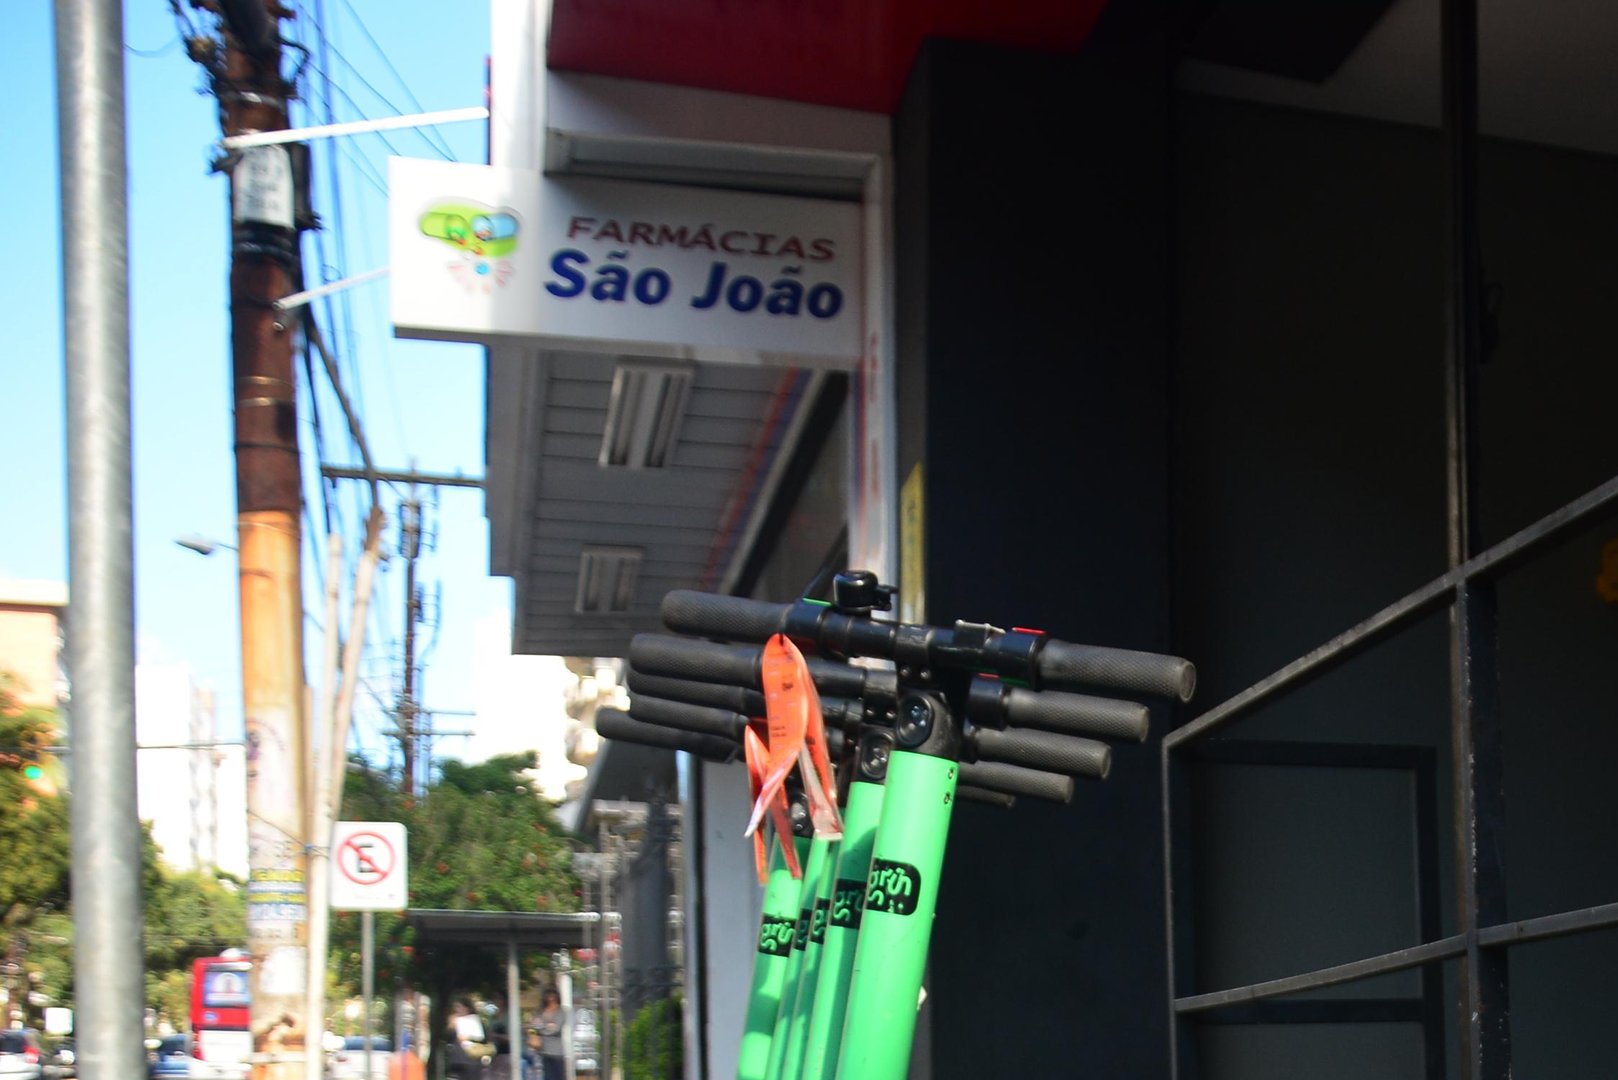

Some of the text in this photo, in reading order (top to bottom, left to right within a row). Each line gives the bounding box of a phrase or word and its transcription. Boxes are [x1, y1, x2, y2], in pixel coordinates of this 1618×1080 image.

[567, 216, 835, 261] FARMÁCIAS
[544, 247, 844, 319] São João
